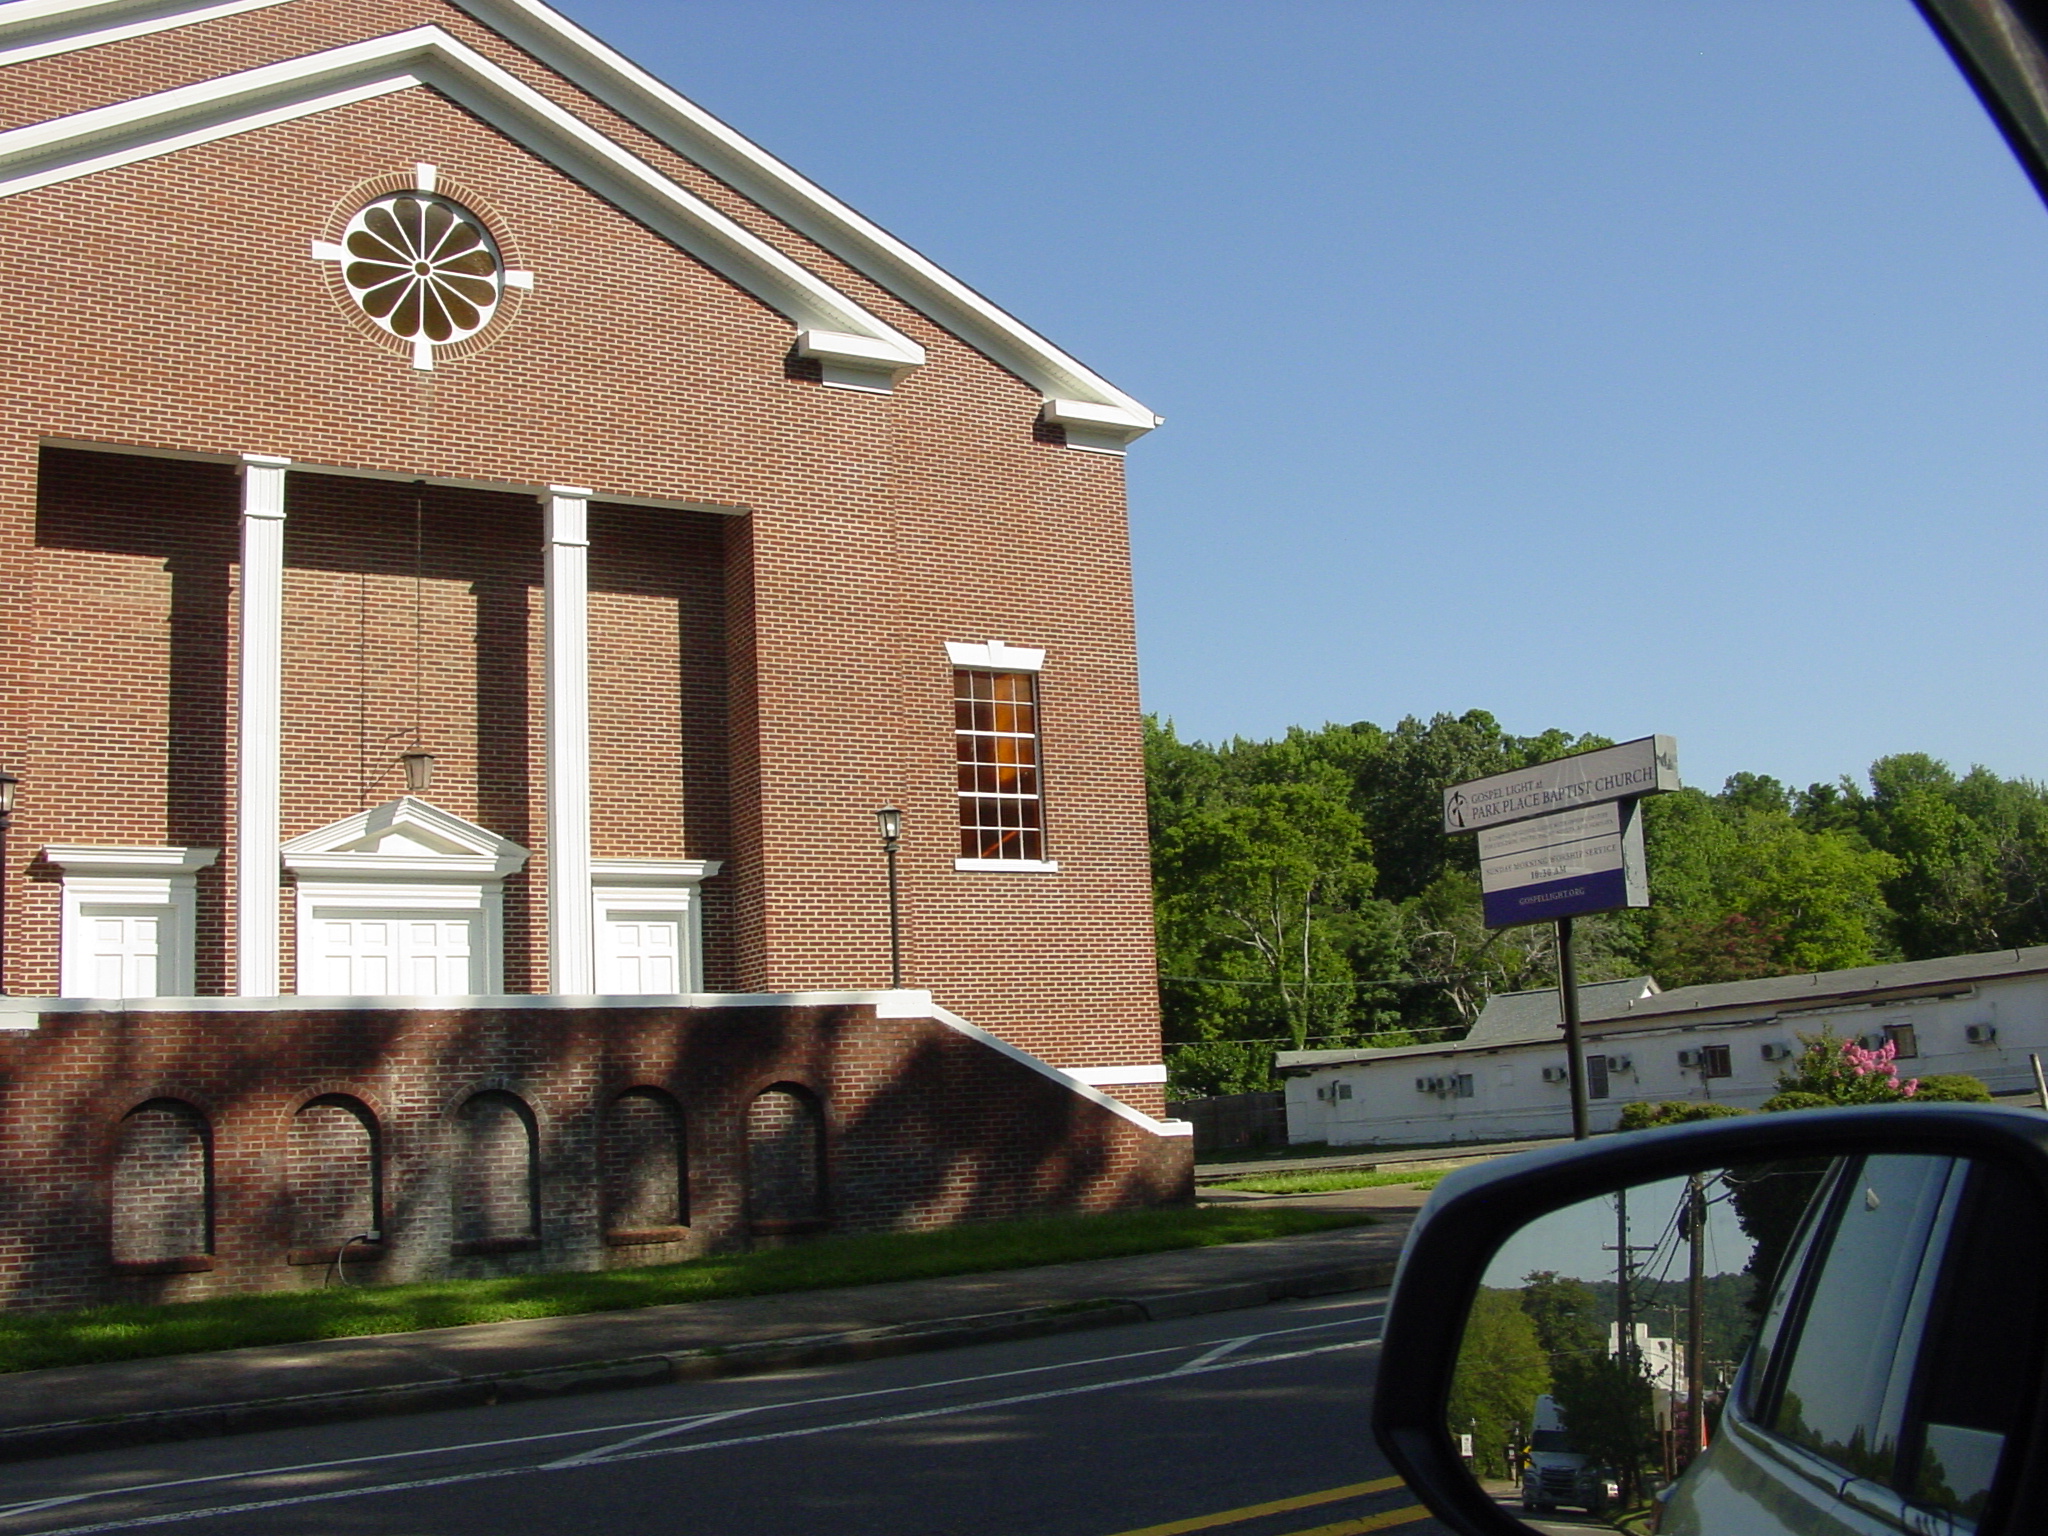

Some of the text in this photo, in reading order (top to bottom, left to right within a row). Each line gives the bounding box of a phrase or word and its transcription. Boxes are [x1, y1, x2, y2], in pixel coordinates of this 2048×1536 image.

[1471, 779, 1543, 803] GOSPEL LIGHT at
[1472, 766, 1653, 820] PARK PLACE BAPTIST CHURCH
[1512, 857, 1549, 871] MORNING
[1584, 844, 1617, 856] SERVICE
[1530, 864, 1567, 880] 10:30 AM
